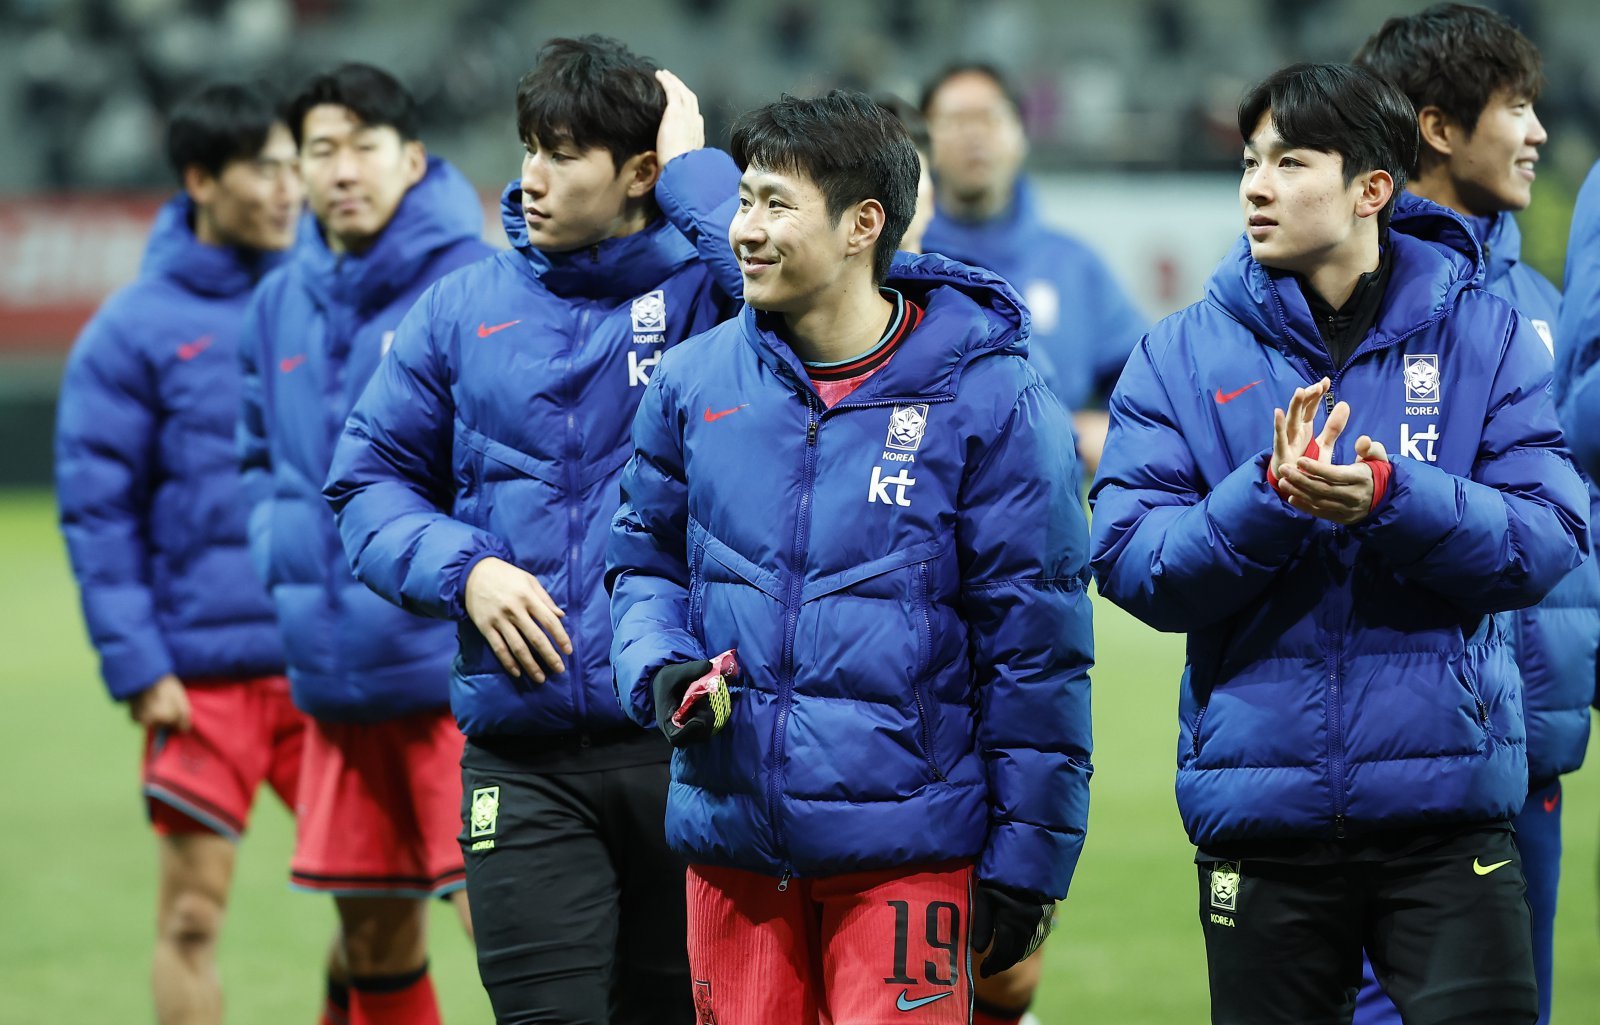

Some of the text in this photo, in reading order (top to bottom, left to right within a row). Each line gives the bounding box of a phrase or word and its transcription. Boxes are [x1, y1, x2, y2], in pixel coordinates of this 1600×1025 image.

[633, 334, 666, 344] KOREA
[1405, 406, 1440, 416] KOREA
[1400, 423, 1440, 462] kt
[882, 451, 915, 463] KOREA
[868, 466, 916, 507] kt
[1210, 913, 1236, 928] KOREA
[883, 900, 960, 986] 19
